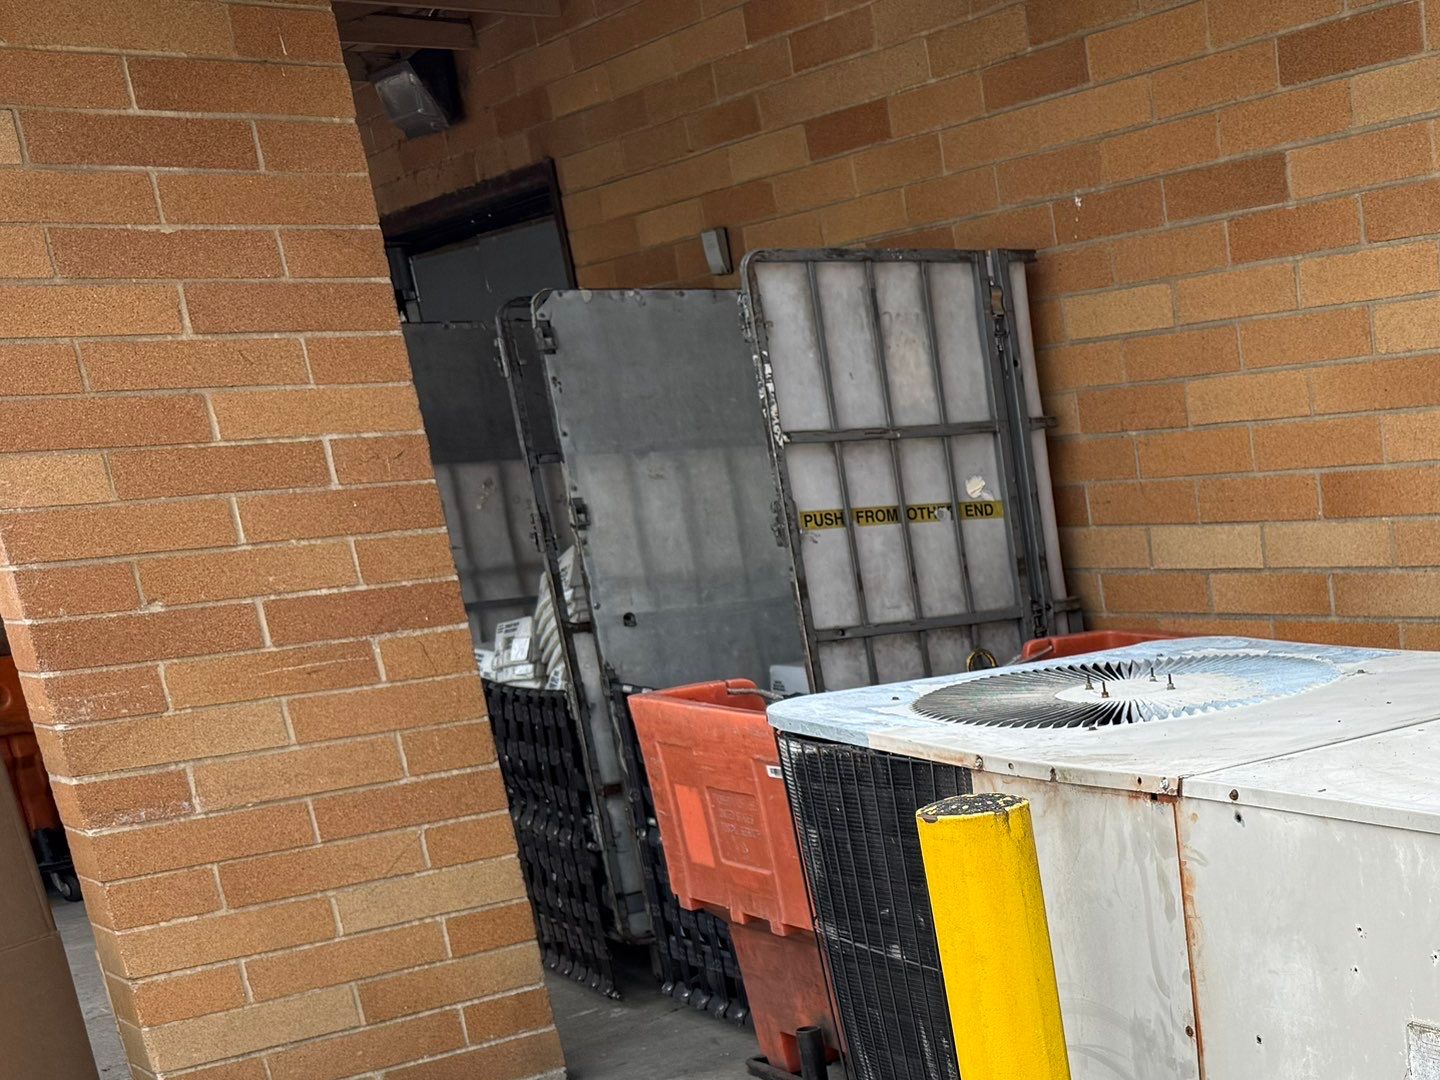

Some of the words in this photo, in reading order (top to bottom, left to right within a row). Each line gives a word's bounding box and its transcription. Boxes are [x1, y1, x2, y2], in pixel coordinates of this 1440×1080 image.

[804, 511, 844, 527] PUSH
[856, 508, 899, 524] FROM
[906, 505, 953, 521] OTH
[965, 503, 994, 517] END
